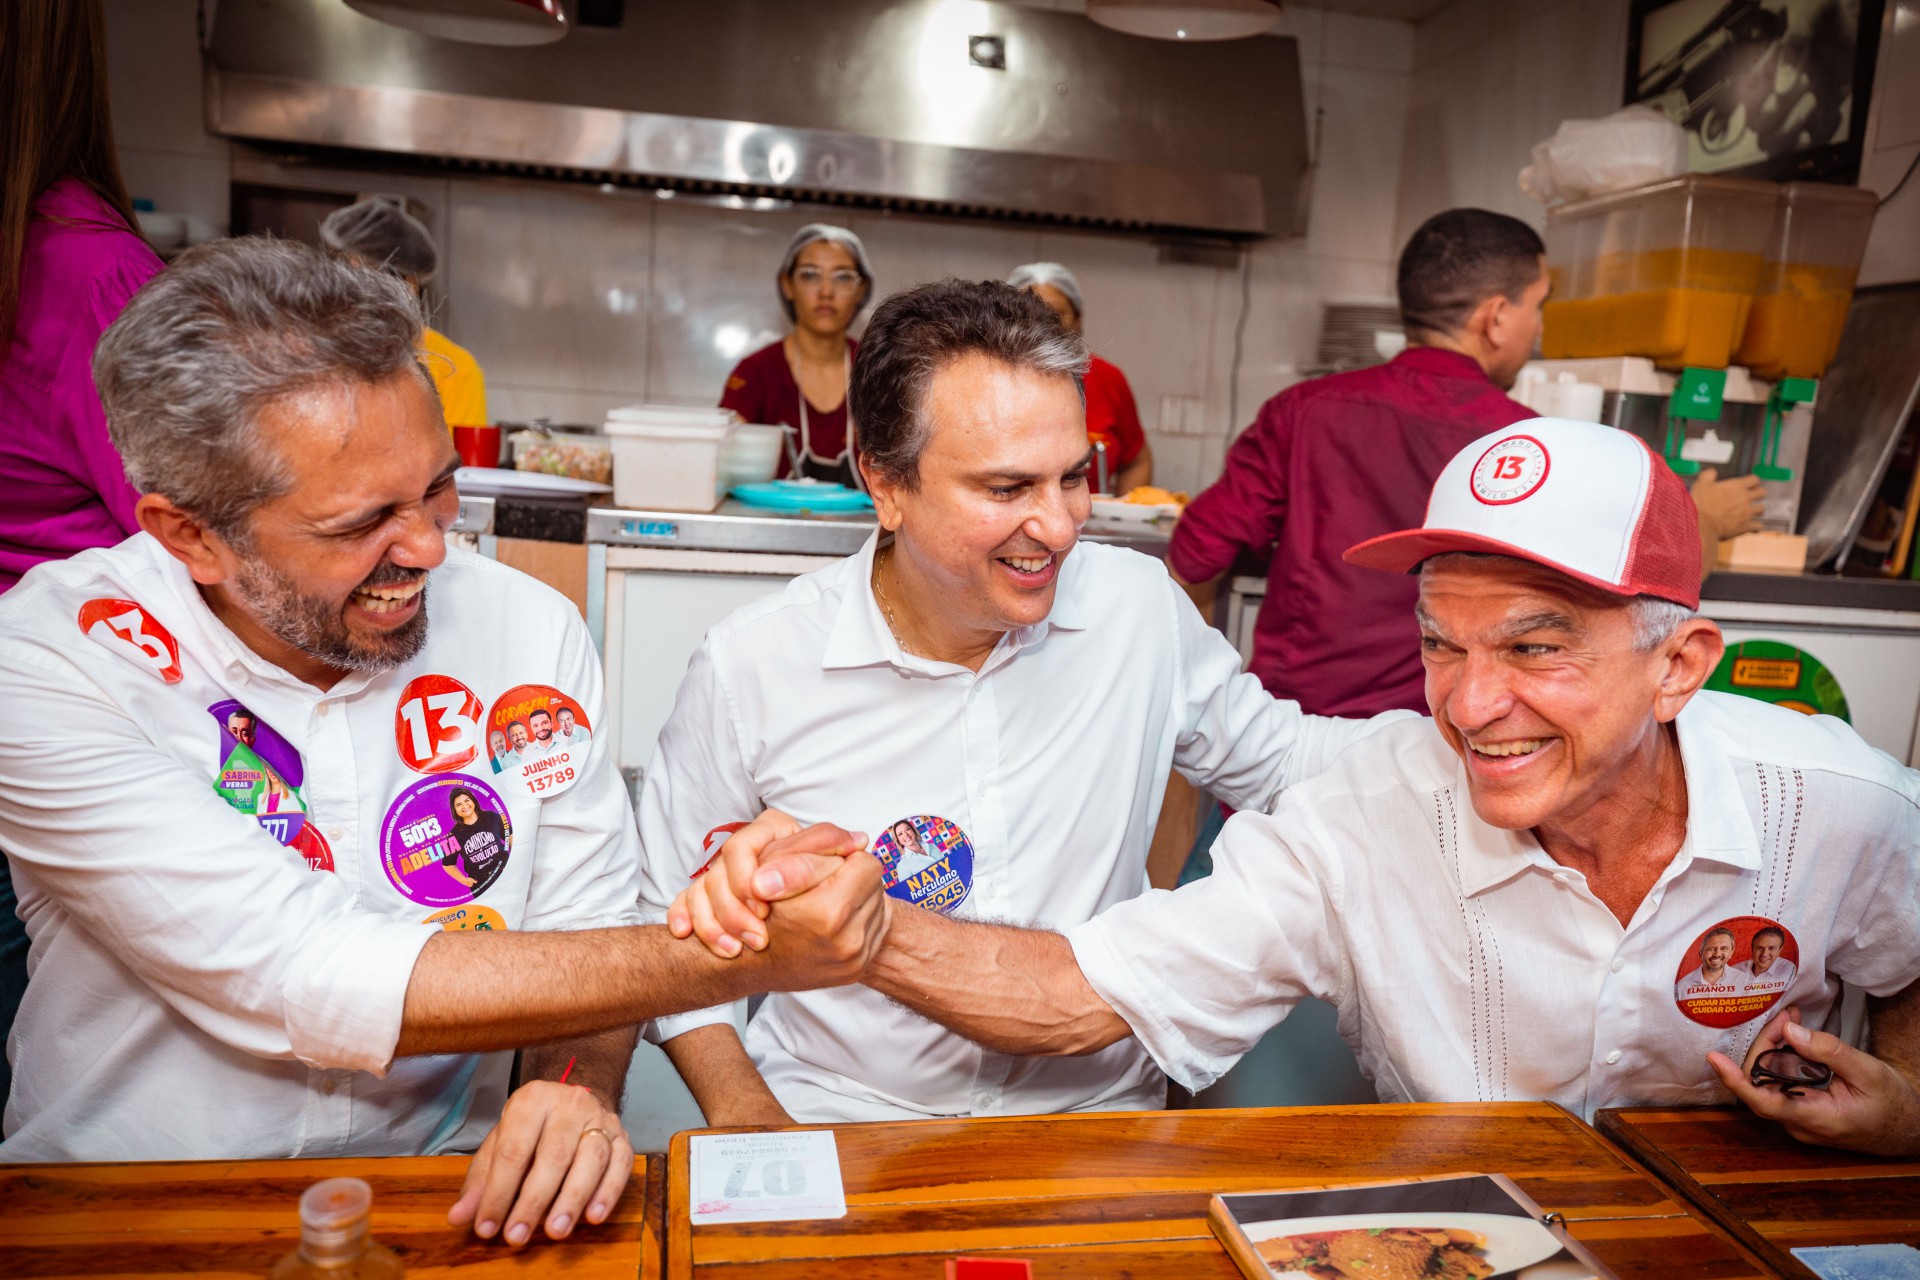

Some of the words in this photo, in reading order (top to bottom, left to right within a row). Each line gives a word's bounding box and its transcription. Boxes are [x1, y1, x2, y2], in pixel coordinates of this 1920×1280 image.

[1493, 455, 1527, 479] 13
[1475, 476, 1507, 499] CAMILO
[87, 608, 173, 677] 13
[495, 695, 550, 726] CORAGEM
[400, 690, 476, 761] 13
[224, 771, 262, 780] SABRINA
[526, 767, 575, 793] 13789
[399, 817, 442, 848] 5013
[463, 831, 495, 855] FEMINISMO
[400, 835, 461, 876] ADELITA
[469, 844, 499, 864] REVOLUÇÃO
[906, 857, 951, 892] NATY
[910, 869, 957, 900] herculano
[1686, 985, 1726, 995] ELMANO
[1727, 985, 1736, 993] 13
[1744, 983, 1772, 991] CAMILO
[1686, 999, 1718, 1008] CUIDAR
[1719, 998, 1736, 1006] DAS
[1737, 995, 1772, 1004] PESSOAS
[1692, 1006, 1724, 1014] CUIDAR
[1739, 1002, 1764, 1011] CEARÁ
[723, 1159, 808, 1199] 07
